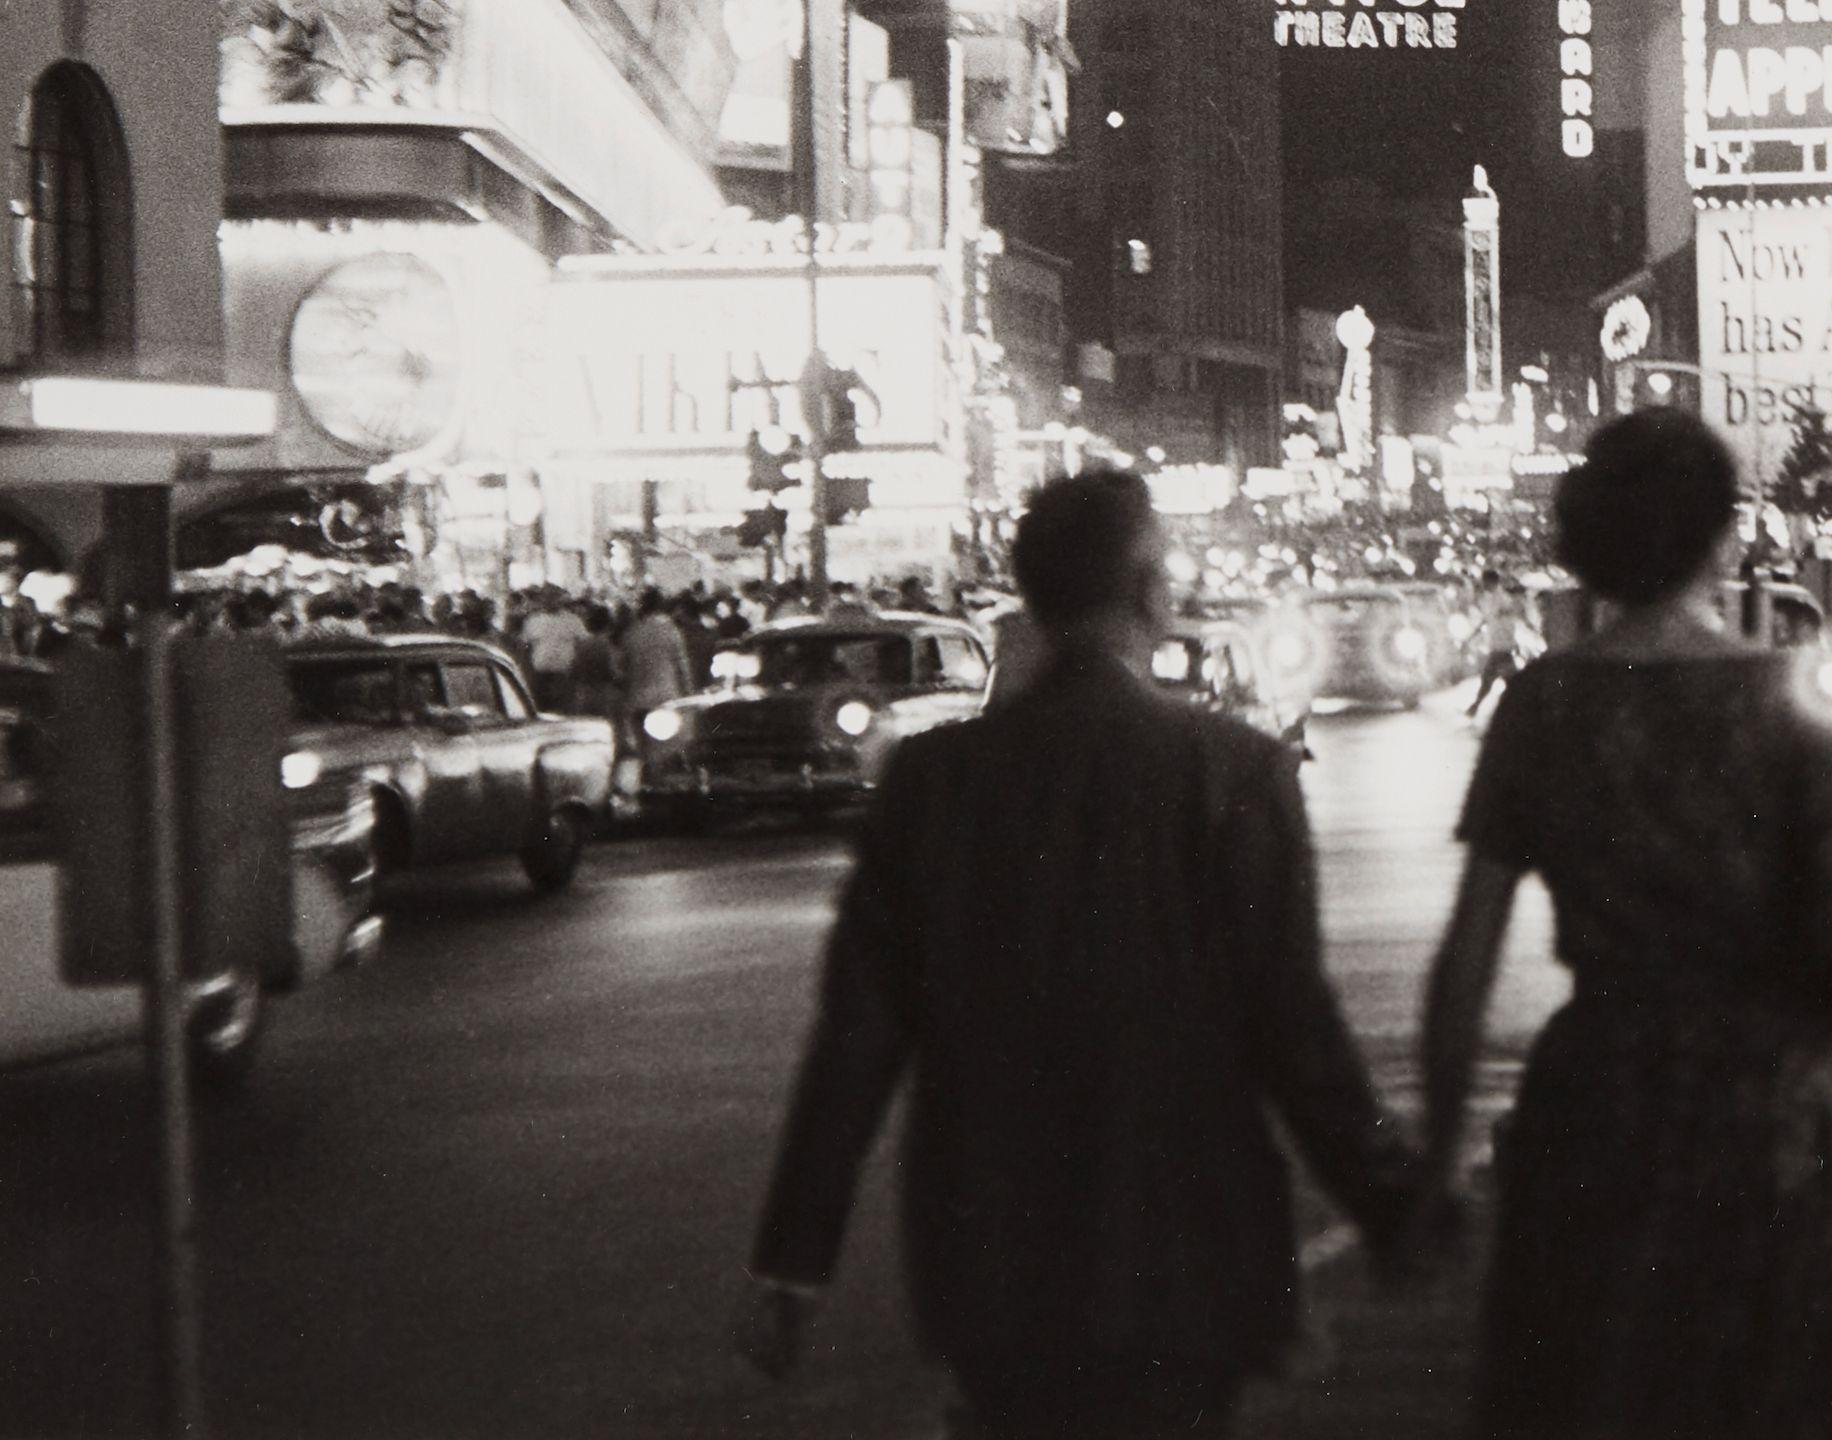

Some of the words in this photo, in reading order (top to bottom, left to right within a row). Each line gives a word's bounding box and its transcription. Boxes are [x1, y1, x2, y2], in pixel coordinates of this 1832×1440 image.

[1273, 10, 1458, 49] THEATRE
[1719, 228, 1809, 283] Now
[1719, 300, 1804, 354] has
